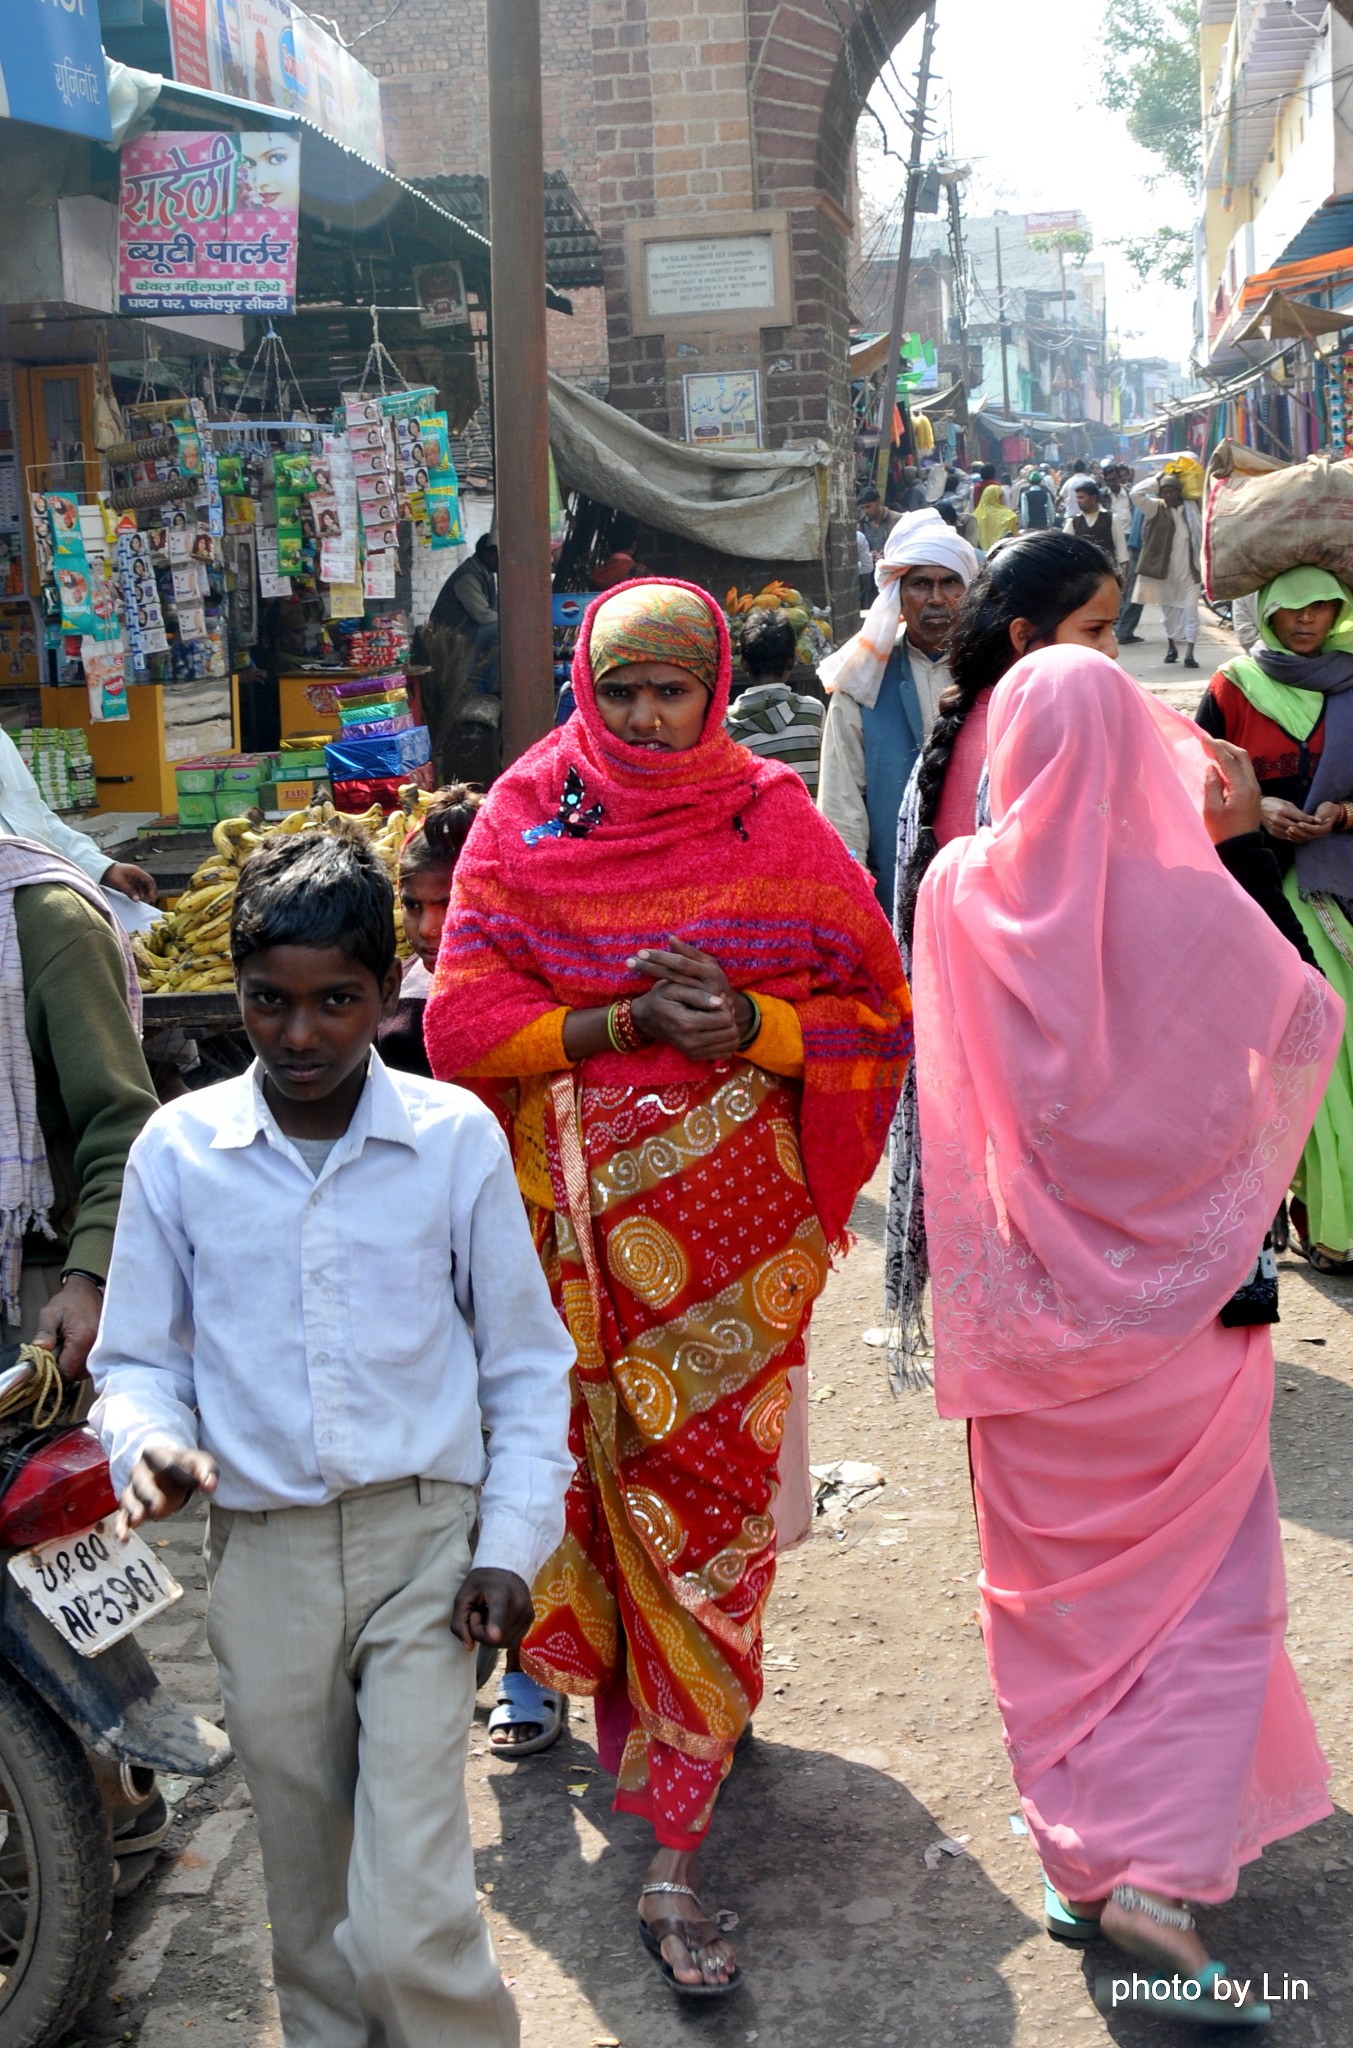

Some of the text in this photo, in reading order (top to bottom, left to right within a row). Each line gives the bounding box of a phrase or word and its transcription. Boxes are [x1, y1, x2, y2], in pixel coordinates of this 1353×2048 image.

[123, 133, 236, 229] सहेली
[127, 232, 291, 275] ब्यूटी पार्लर
[135, 280, 281, 292] केवल महिलाओं के लिये
[189, 296, 242, 313] फतेहपुर
[245, 296, 288, 310] सीकरी
